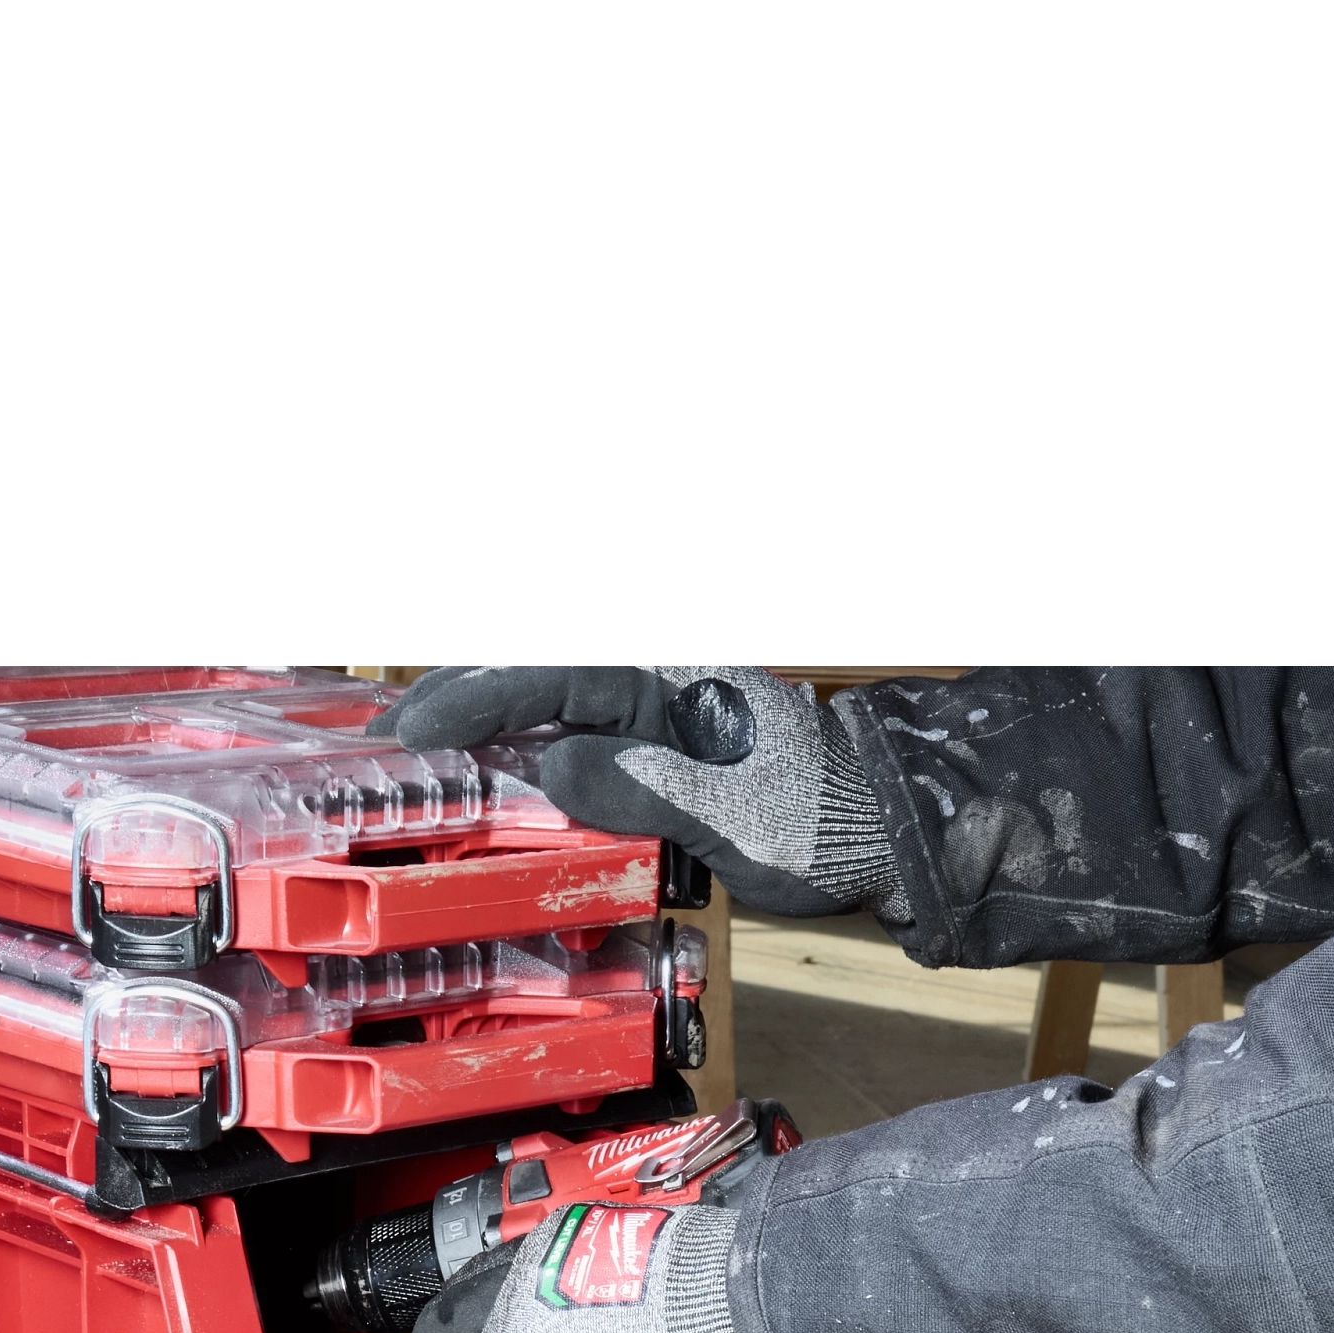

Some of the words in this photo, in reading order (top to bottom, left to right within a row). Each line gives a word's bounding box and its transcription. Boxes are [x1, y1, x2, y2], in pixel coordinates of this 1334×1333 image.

[582, 1114, 716, 1170] Milwauke
[450, 1221, 464, 1239] 10
[563, 1217, 577, 1237] CUT
[549, 1238, 570, 1269] LEVEL
[621, 1211, 654, 1277] Milwaukee
